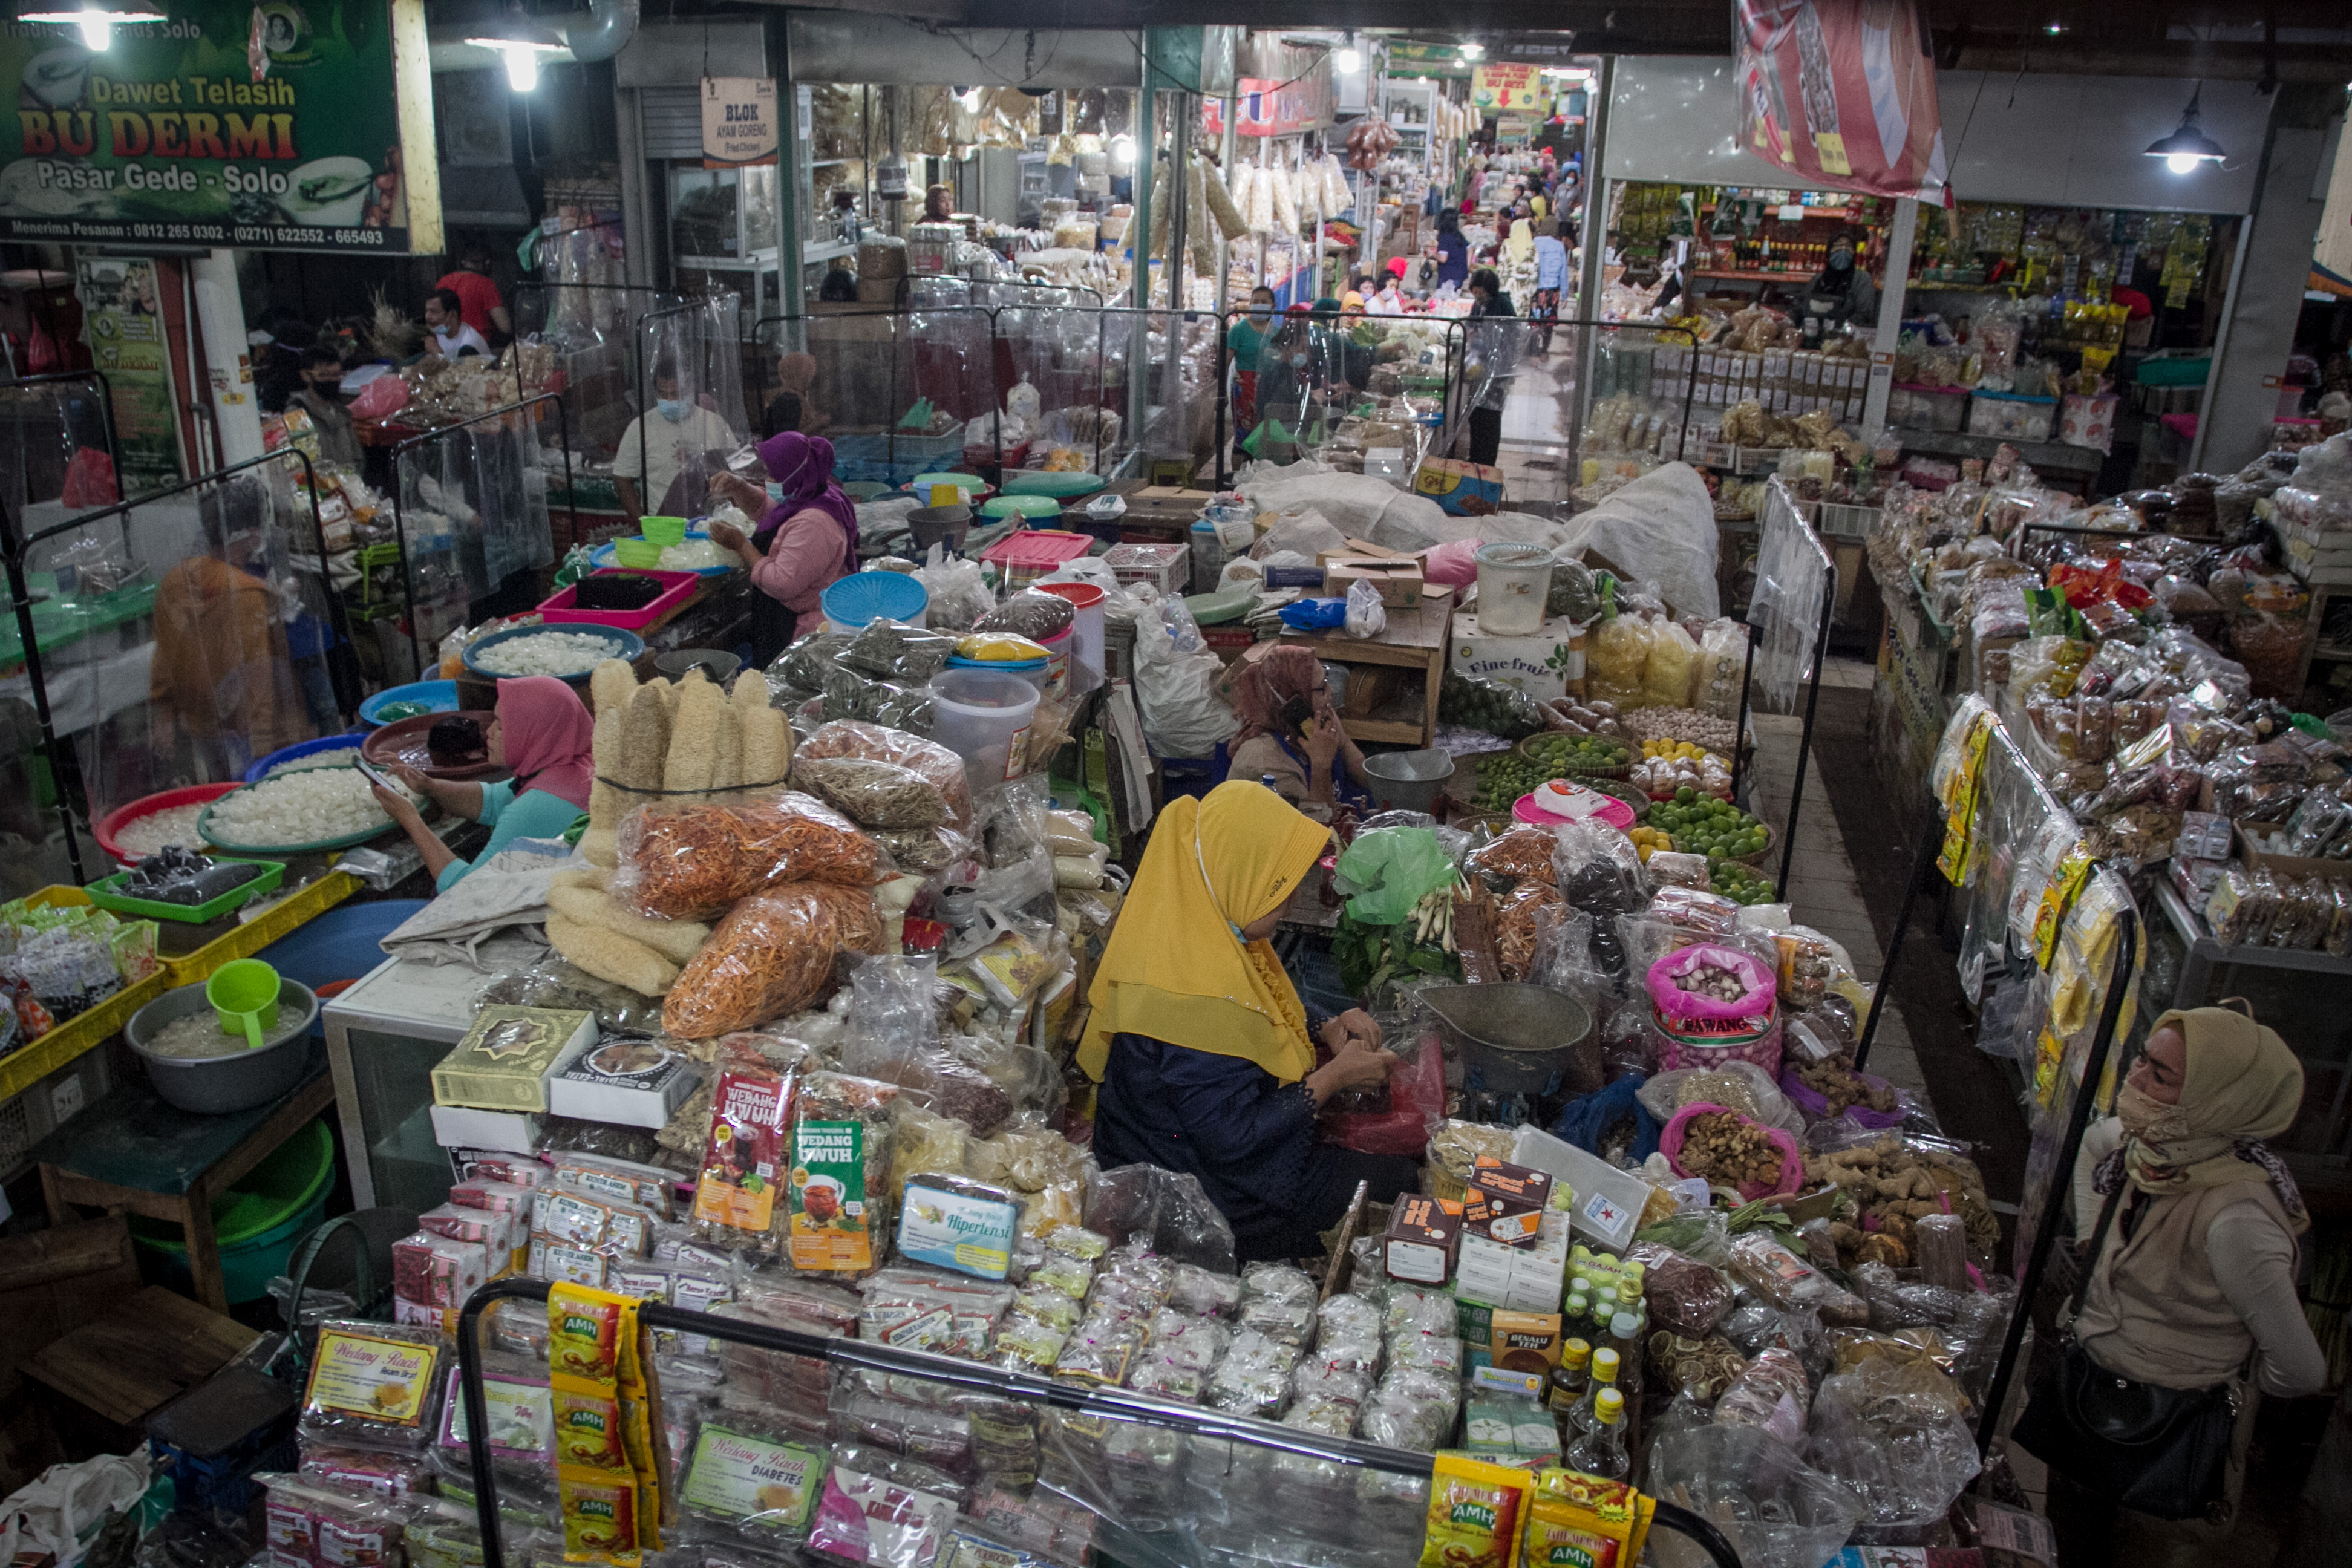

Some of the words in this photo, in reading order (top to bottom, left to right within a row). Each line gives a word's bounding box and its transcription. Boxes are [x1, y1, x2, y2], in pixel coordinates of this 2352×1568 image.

[162, 18, 201, 39] Solo
[93, 76, 181, 104] Dawet
[189, 77, 295, 105] Telasih
[726, 104, 758, 121] BLOK
[18, 110, 97, 155] BU
[109, 111, 298, 159] DERMI
[717, 124, 736, 139] AYAM
[738, 123, 767, 137] GORENG
[38, 162, 115, 190] Pasar
[124, 163, 198, 191] Gede
[224, 166, 289, 195] Solo
[12, 220, 70, 235] Menerima
[72, 222, 124, 237] Pesanan
[134, 224, 165, 238] 0812
[167, 226, 190, 239] 265
[193, 226, 224, 240] 0302
[234, 227, 275, 244] (0271)
[277, 229, 325, 243] 622552
[335, 229, 384, 245] 665493
[1469, 661, 1508, 675] Fine
[1512, 658, 1546, 676] frui
[1684, 1017, 1747, 1033] BAWANG
[727, 1087, 777, 1109] WEDANG
[797, 1135, 852, 1146] WEDANG
[798, 1148, 853, 1163] UWUH
[947, 1214, 1011, 1239] Hipertensi
[1588, 1261, 1622, 1274] GAJAH
[566, 1318, 598, 1336] AMH
[1511, 1334, 1549, 1344] BENALU
[1518, 1341, 1538, 1349] TEH
[333, 1341, 380, 1367] Wedang
[382, 1350, 422, 1370] Racik
[572, 1411, 604, 1429] AMH
[710, 1436, 760, 1465] Wedang
[768, 1451, 809, 1472] Racik
[751, 1465, 805, 1486] DIABETES
[580, 1500, 613, 1515] AMH
[1453, 1504, 1494, 1524] AMH
[1545, 1527, 1568, 1542] JAHE
[1571, 1532, 1606, 1552] MERAH
[1553, 1547, 1592, 1568] AMH
